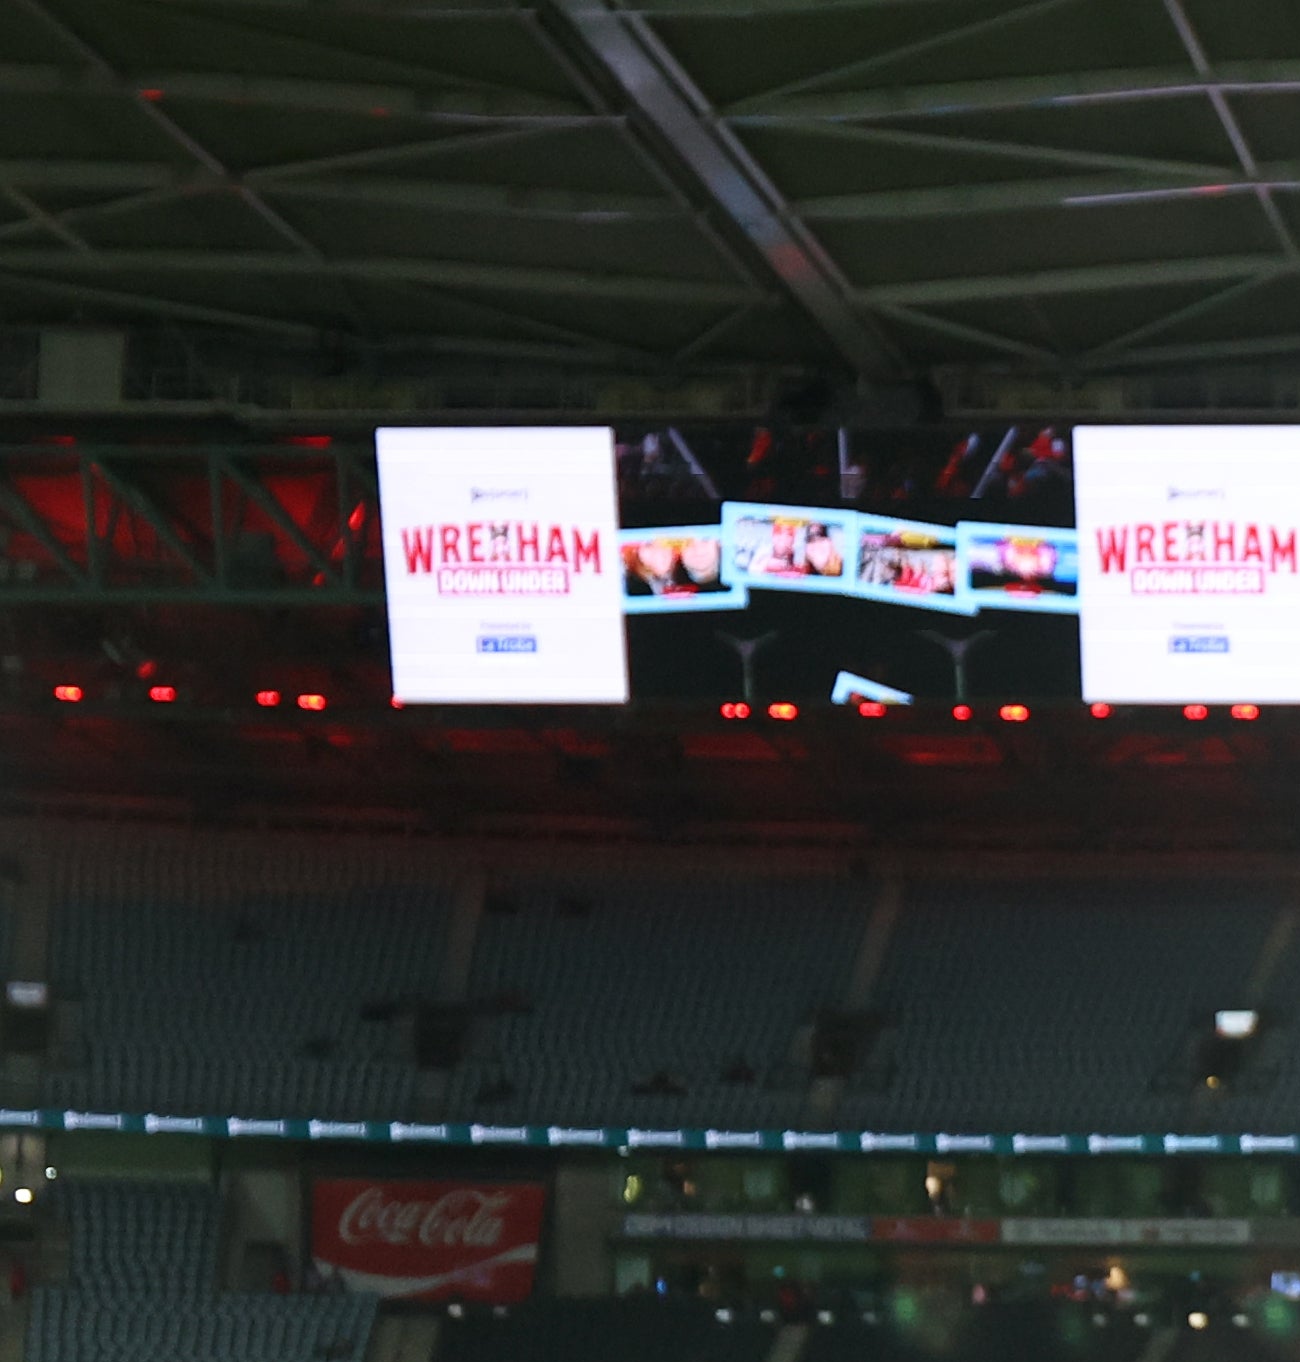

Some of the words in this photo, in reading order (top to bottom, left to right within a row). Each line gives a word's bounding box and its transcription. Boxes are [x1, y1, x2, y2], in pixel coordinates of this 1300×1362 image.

[401, 521, 603, 574] WREXHAM
[1095, 521, 1298, 574] WREXHAM
[442, 572, 500, 592] DOWN
[502, 572, 566, 592] UNDER
